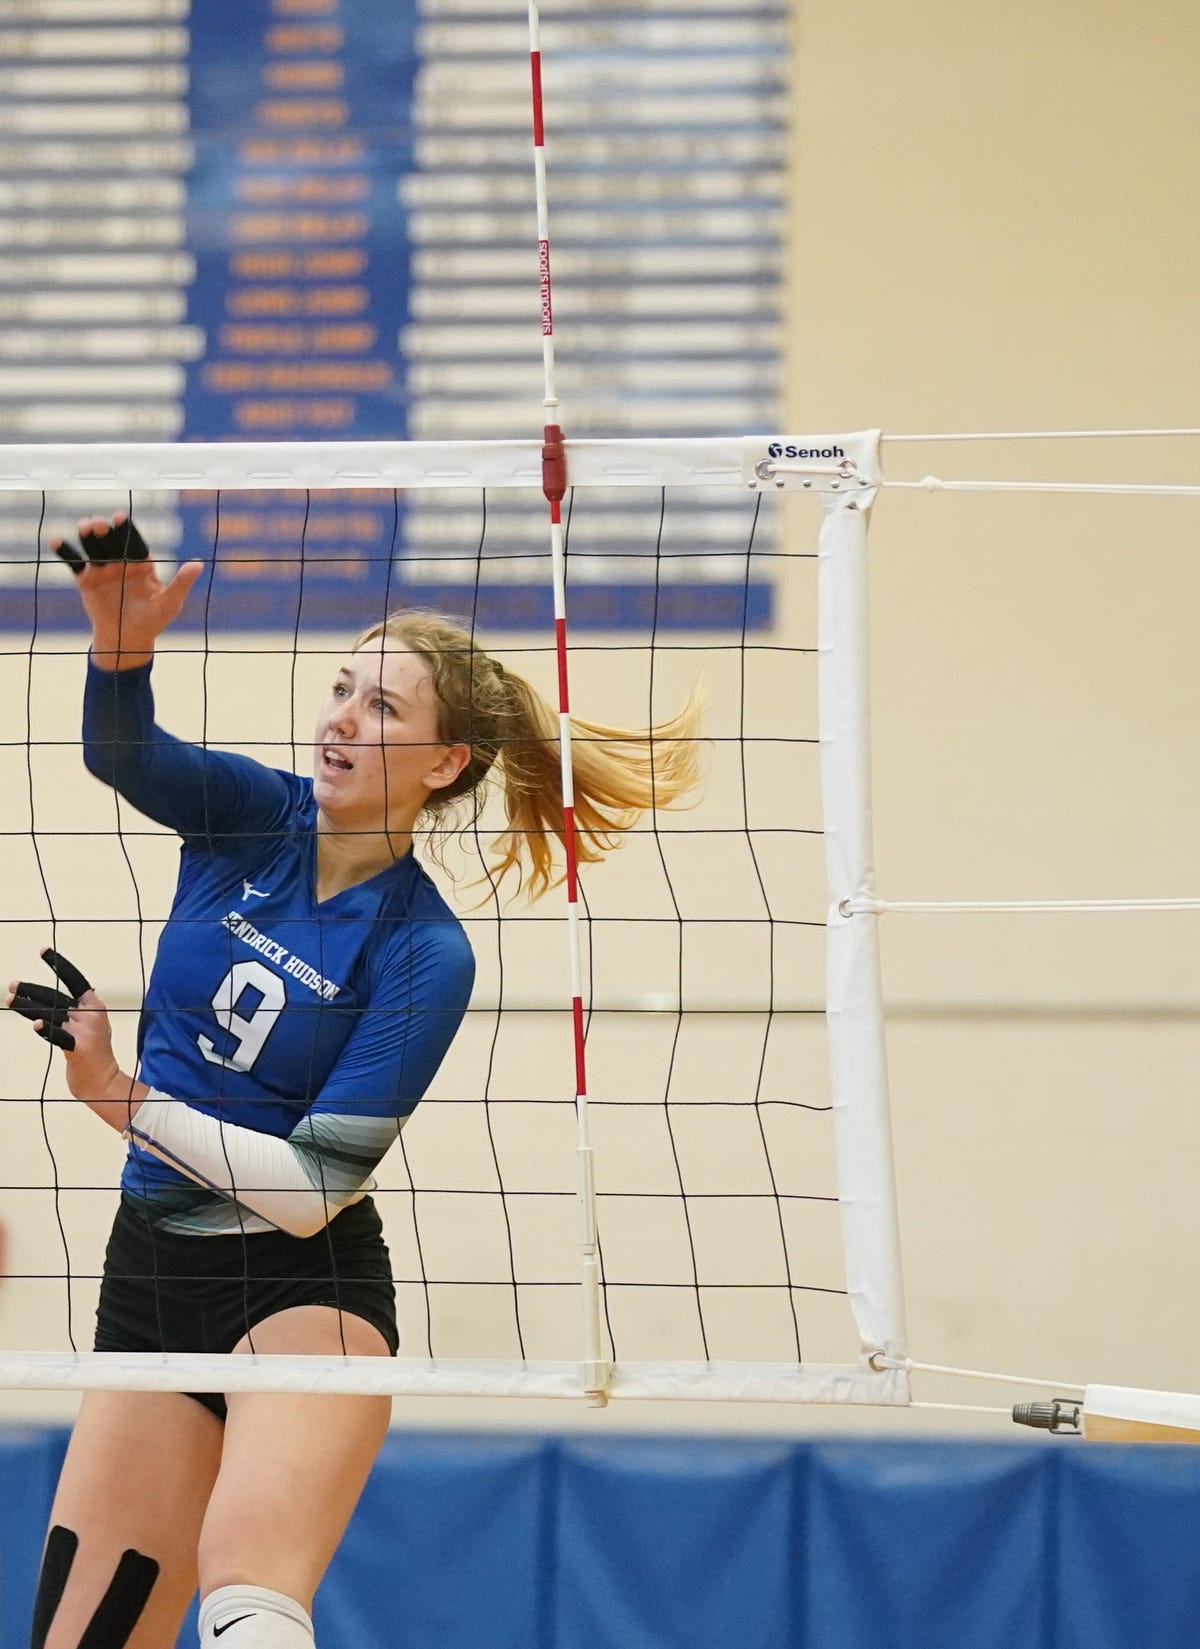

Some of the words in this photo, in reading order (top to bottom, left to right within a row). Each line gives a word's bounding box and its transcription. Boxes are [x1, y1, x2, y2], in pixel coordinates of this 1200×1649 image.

[785, 445, 845, 459] Senoh
[282, 955, 341, 1001] HUDSON
[196, 959, 288, 1073] 9
